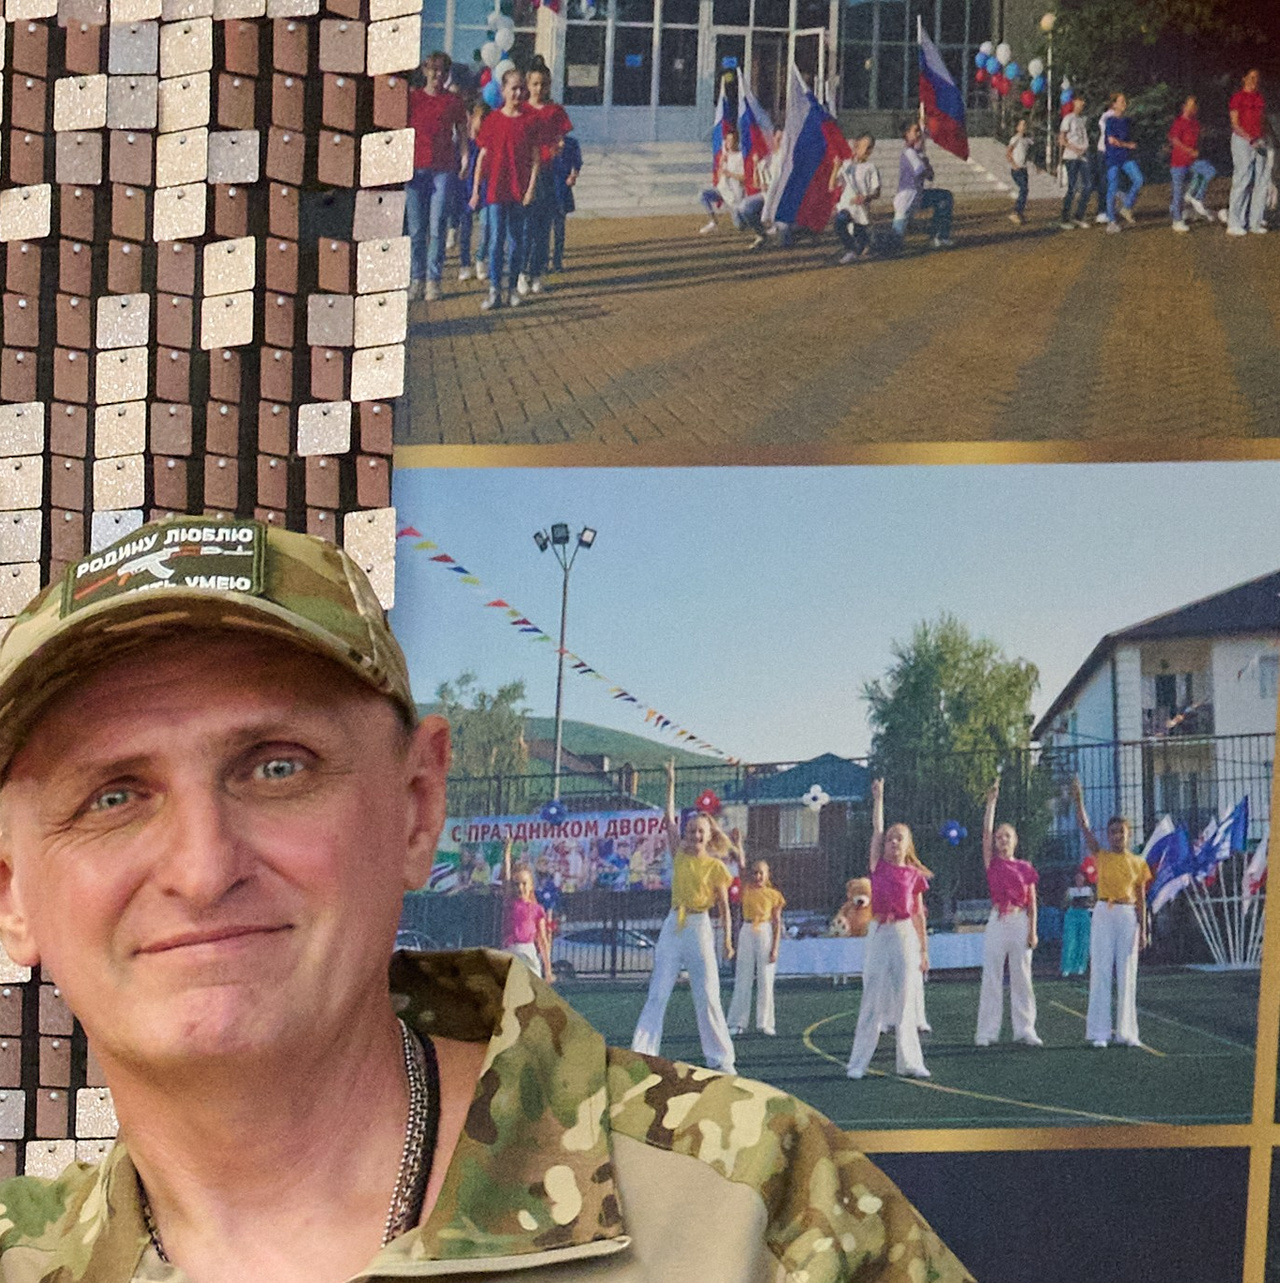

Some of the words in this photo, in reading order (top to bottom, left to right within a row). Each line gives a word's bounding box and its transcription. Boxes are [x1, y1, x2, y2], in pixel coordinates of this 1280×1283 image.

[76, 532, 159, 578] РОДИНУ
[164, 528, 253, 544] ЛЮБЛЮ
[185, 576, 251, 590] УМЕЮ
[451, 825, 462, 843] С
[468, 820, 598, 843] ПРАЗДНИКОМ
